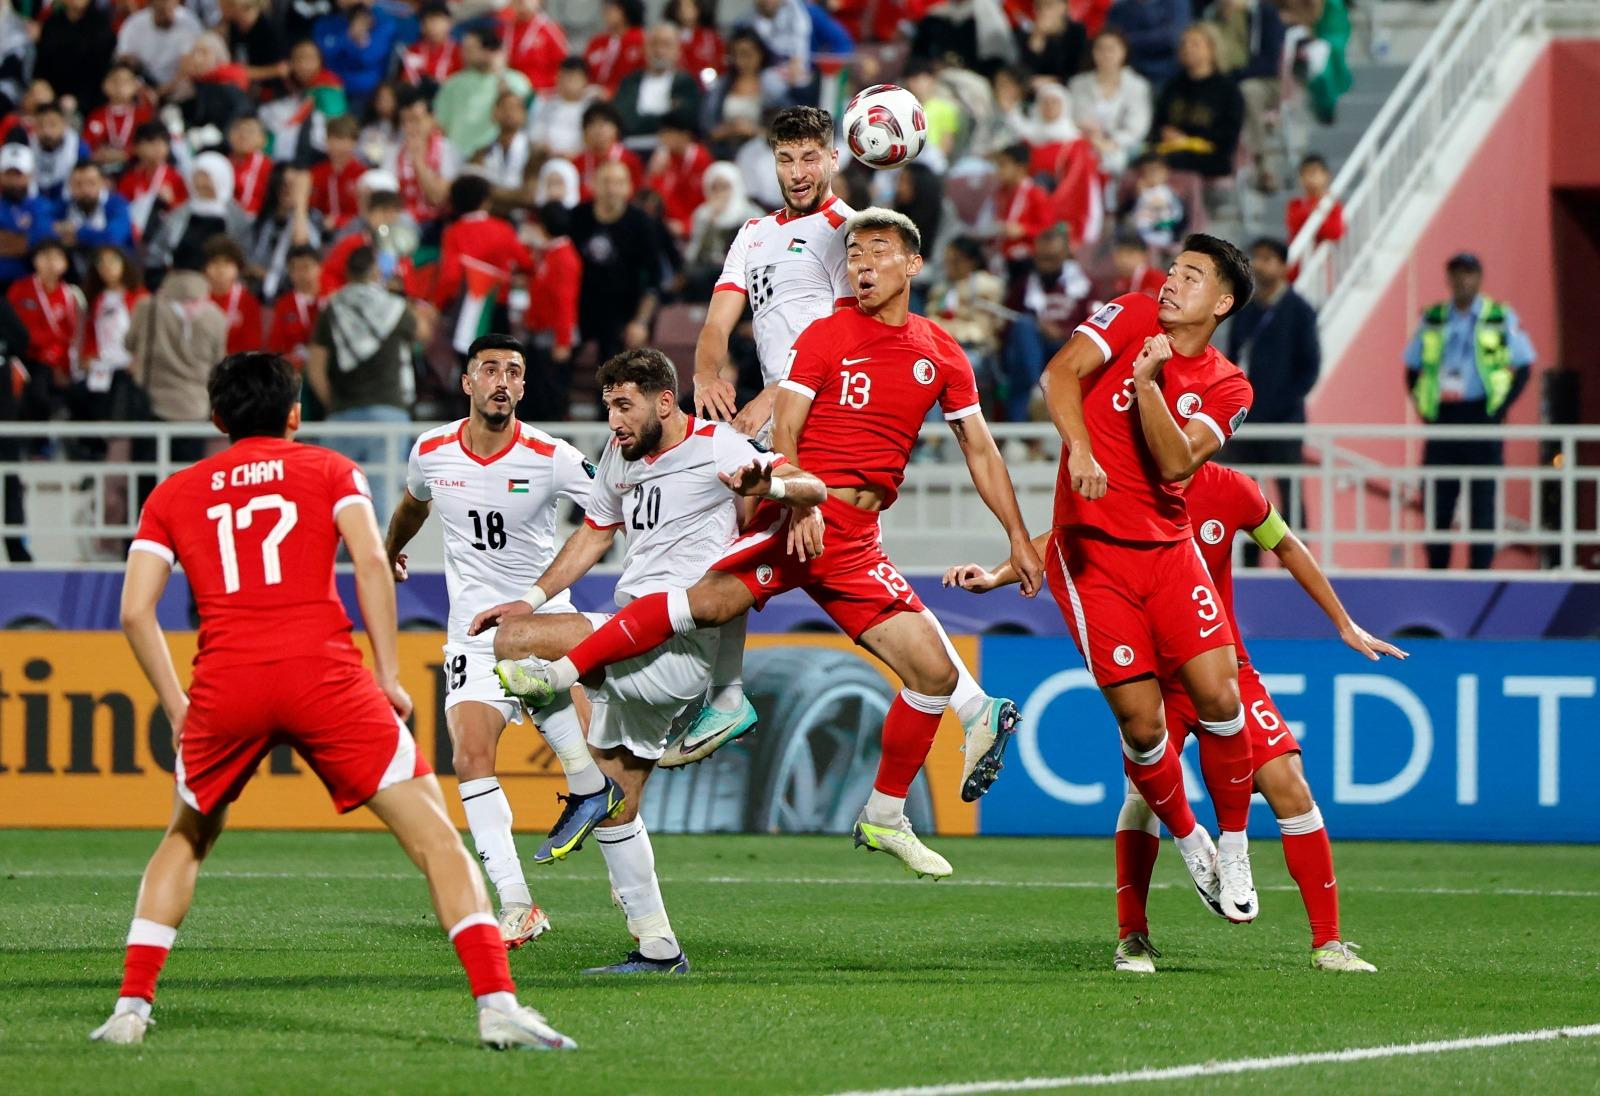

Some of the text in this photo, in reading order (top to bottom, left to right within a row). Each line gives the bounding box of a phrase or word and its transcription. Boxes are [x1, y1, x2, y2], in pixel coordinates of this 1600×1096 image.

[839, 371, 871, 409] 13
[1112, 378, 1137, 412] 3
[211, 459, 284, 491] S CHAN
[433, 479, 466, 488] KELME
[632, 484, 661, 530] 20
[207, 494, 298, 594] 17
[468, 510, 507, 551] 18
[867, 562, 908, 598] 13
[1191, 585, 1218, 621] 3
[1251, 700, 1280, 731] 6
[1017, 668, 1596, 807] CDIT
